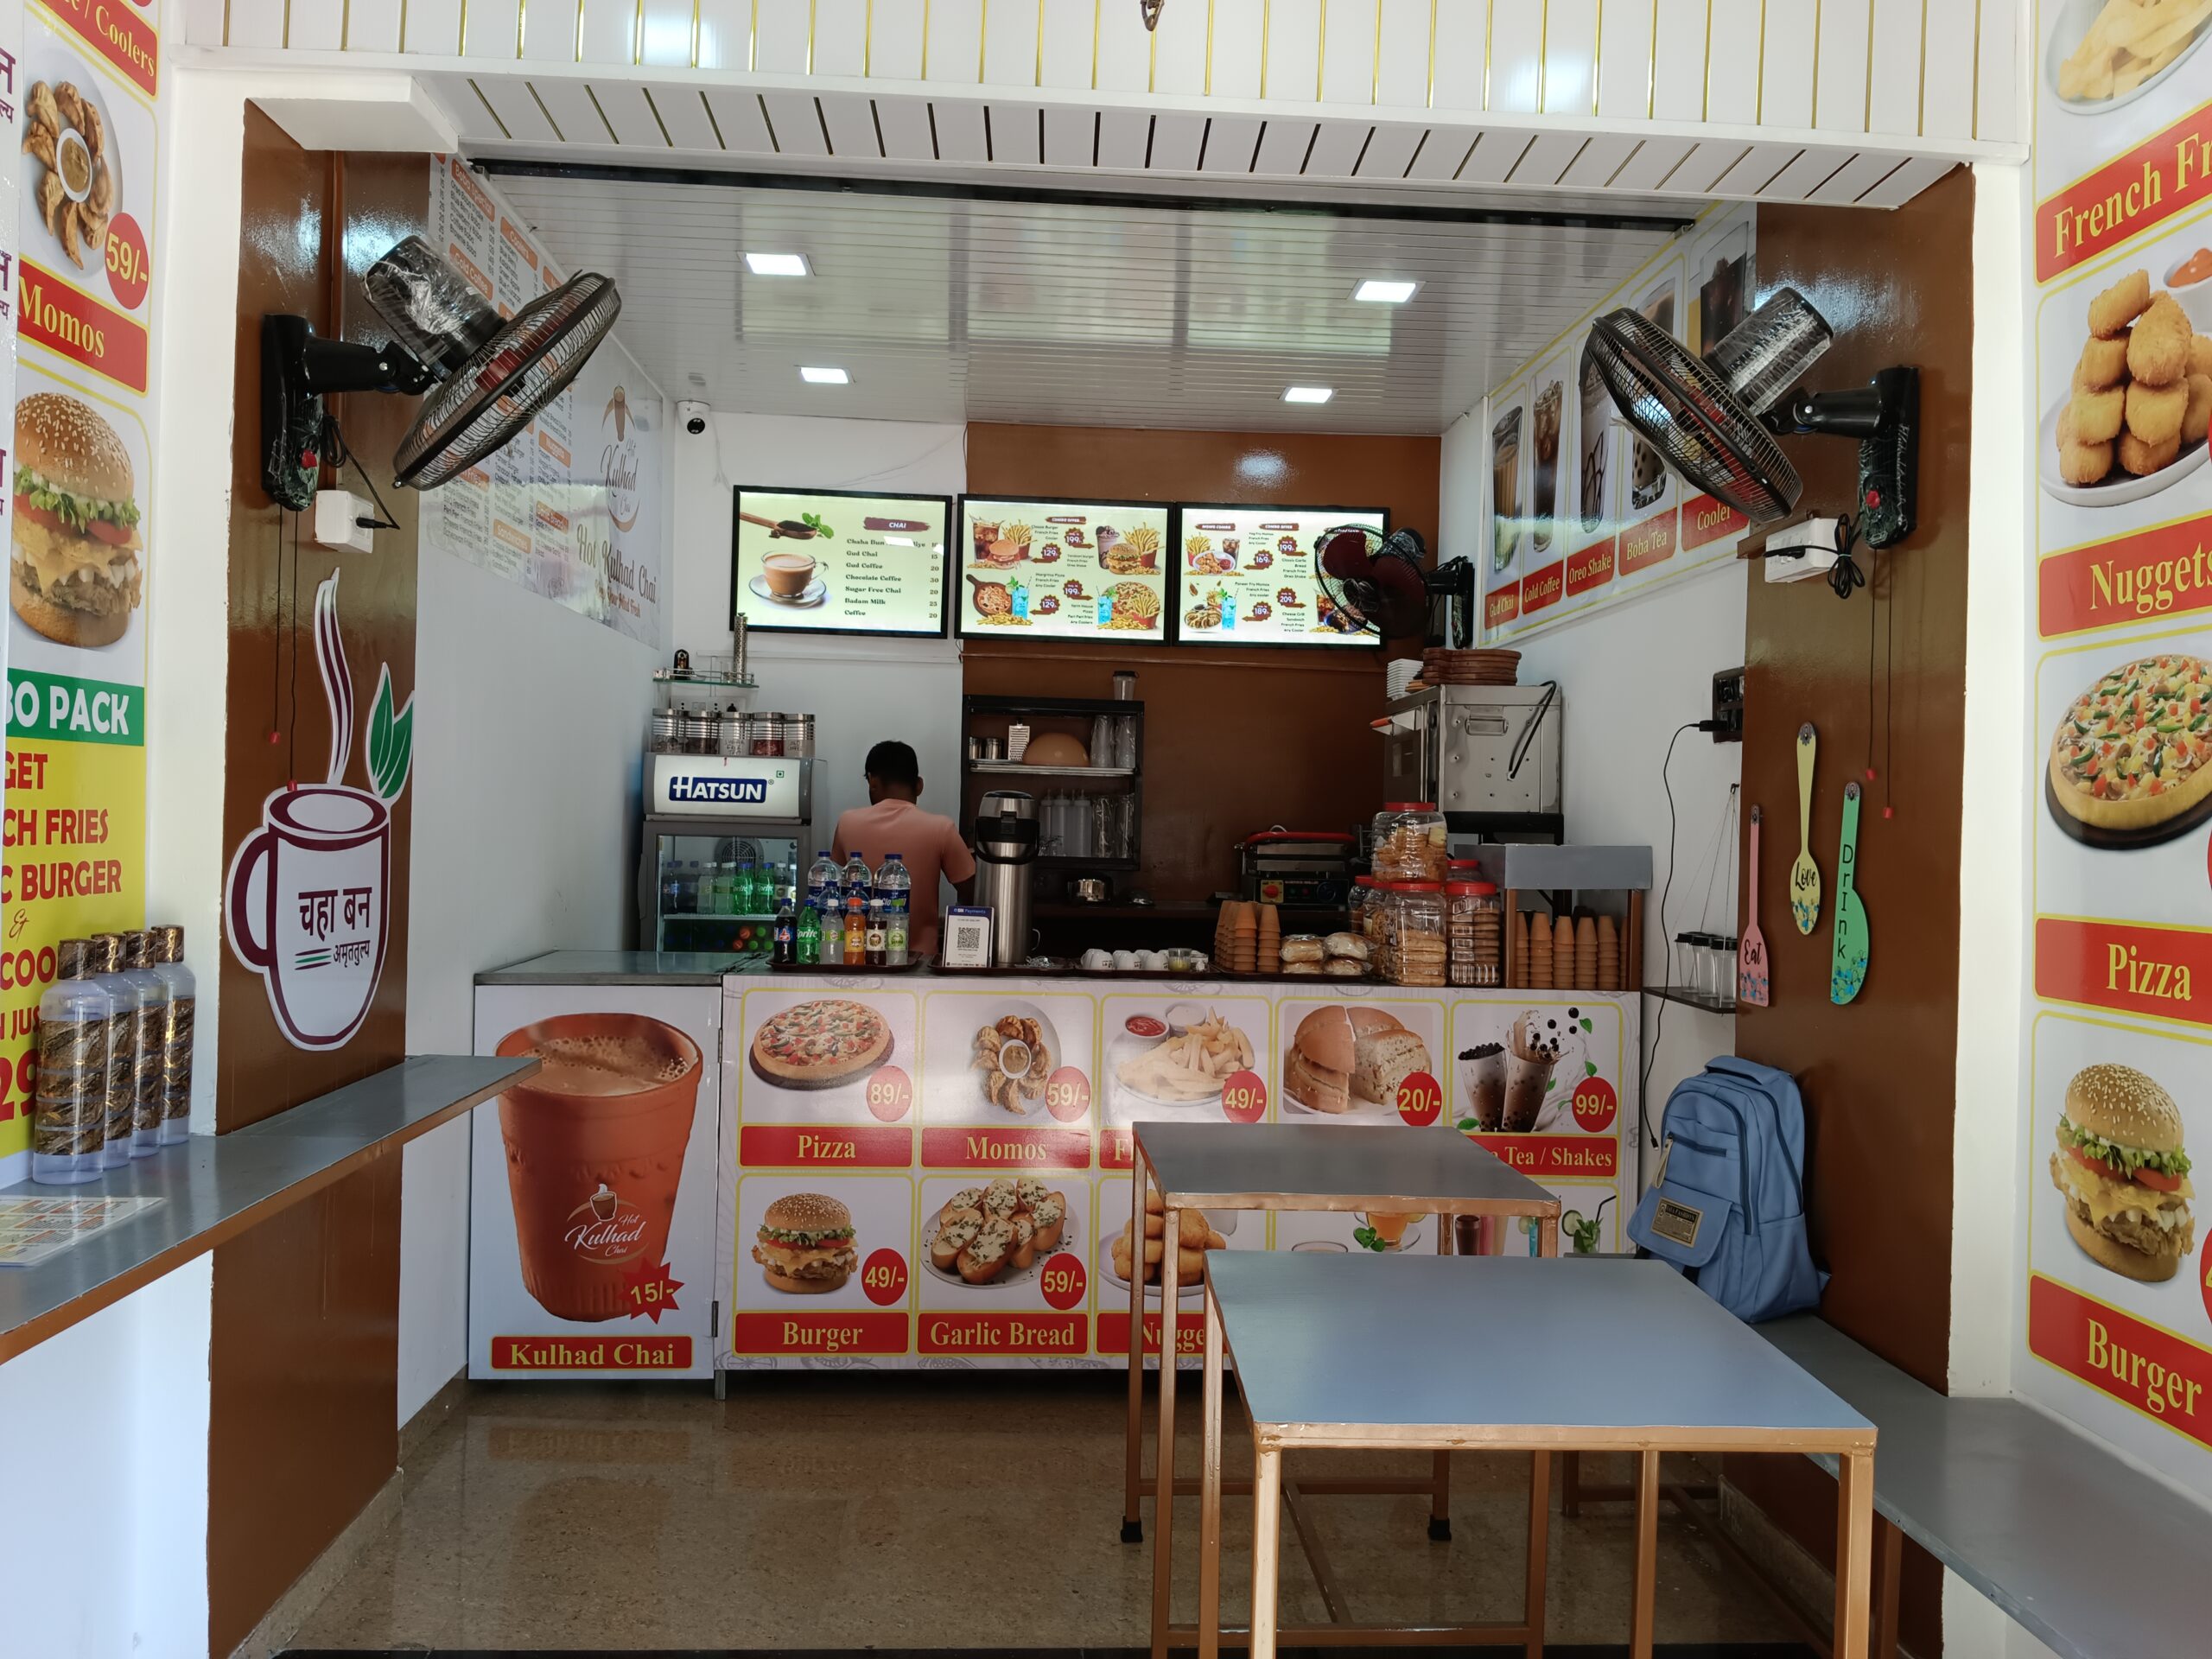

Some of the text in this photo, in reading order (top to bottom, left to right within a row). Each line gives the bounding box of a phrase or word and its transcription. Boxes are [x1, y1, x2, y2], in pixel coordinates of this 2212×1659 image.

[95, 5, 154, 77] Coolers
[2053, 161, 2162, 259] French
[105, 232, 148, 285] 59/-
[17, 275, 105, 358] Momos
[600, 444, 639, 497] Kulhad
[1626, 529, 1668, 562] Boba Tea
[576, 524, 597, 568] Hot
[602, 540, 635, 592] Kulhad
[639, 565, 657, 604] Chai
[1569, 553, 1612, 585] Oreo Shake
[1524, 575, 1560, 603] Cold Coffee
[1501, 594, 1515, 613] Chai
[49, 685, 130, 736] PACK
[672, 777, 762, 801] HATSUN
[45, 808, 109, 845] FRIES
[21, 859, 122, 902] BURGER
[1795, 861, 1817, 891] Love
[298, 887, 372, 943] चहा बन
[1745, 938, 1763, 966] Eat
[2107, 943, 2192, 1001] Pizza
[870, 1083, 909, 1104] 89/-
[1047, 1083, 1090, 1106] 59/-
[1225, 1087, 1264, 1109] 49/-
[1398, 1088, 1440, 1112] 20/-
[1575, 1093, 1614, 1116] 99/-
[797, 1135, 856, 1159] Pizza
[966, 1135, 1048, 1160] Momos
[1504, 1146, 1535, 1166] Tea
[1540, 1147, 1547, 1165] /
[1551, 1147, 1612, 1166] Shakes
[618, 1213, 640, 1226] Hot
[564, 1221, 646, 1250] Kulhad
[605, 1245, 629, 1256] Chai
[865, 1266, 905, 1287] 49/-
[1044, 1270, 1084, 1293] 59/-
[630, 1280, 675, 1305] 15/-
[782, 1321, 863, 1351] Burger
[930, 1323, 1075, 1345] Garlic Bread
[511, 1344, 674, 1365] Kulhad Chai
[2086, 1318, 2202, 1416] Burger
